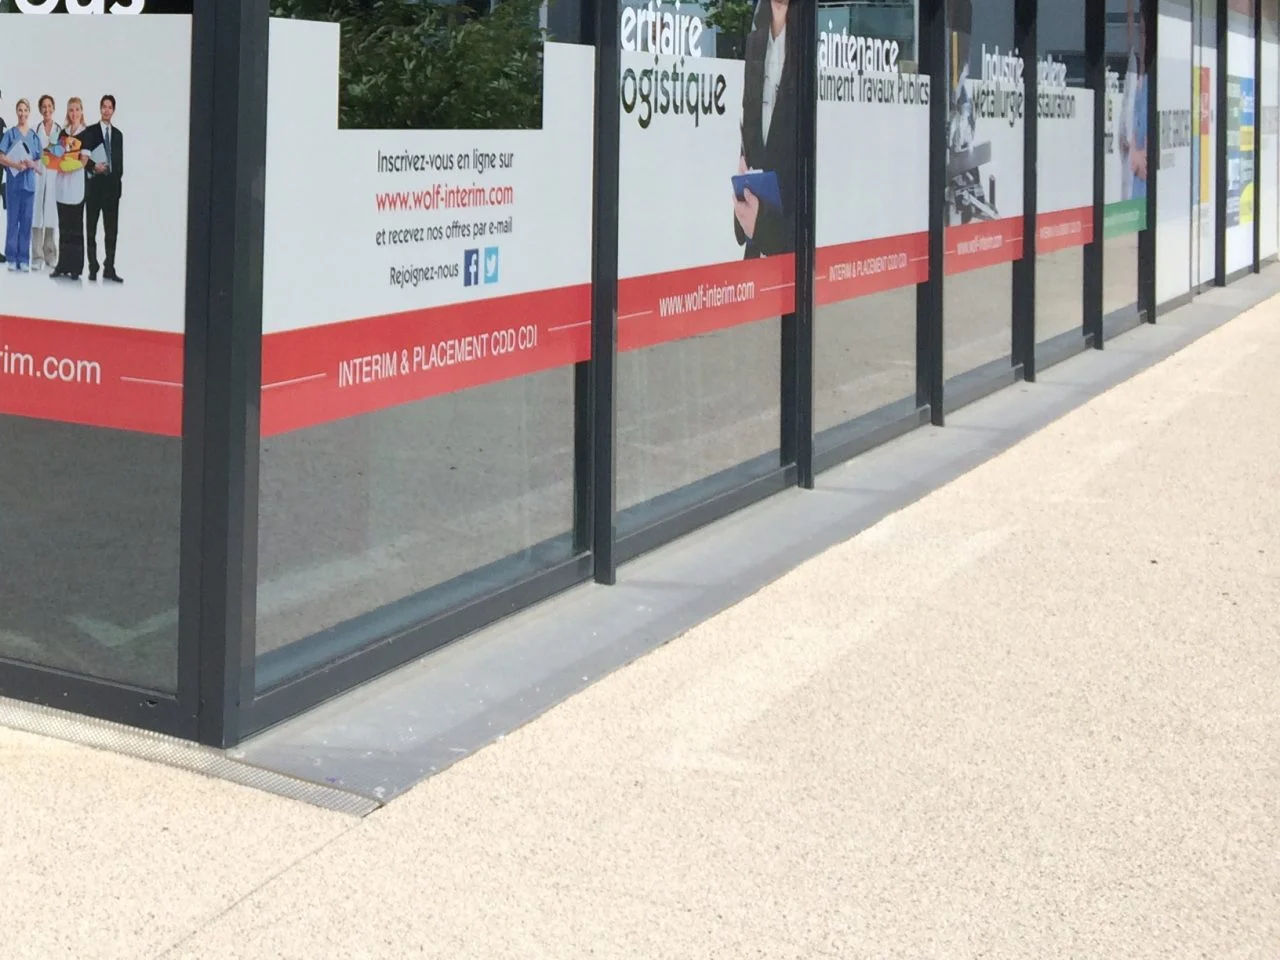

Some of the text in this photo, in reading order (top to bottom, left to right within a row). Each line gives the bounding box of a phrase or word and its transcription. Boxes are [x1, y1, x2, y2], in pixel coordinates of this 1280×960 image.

[818, 19, 899, 73] aintenance
[621, 55, 727, 129] ogistique
[819, 67, 855, 102] timent
[857, 70, 895, 103] Travaux
[377, 148, 514, 174] Inscrivez-vous en ligne sur
[376, 183, 513, 212] www.wolf-interim.com
[375, 216, 512, 246] et recevez nos offres par e-mail
[390, 262, 459, 288] Rejoignez-nous
[659, 280, 755, 317] www.wolf-interim.com
[338, 325, 537, 387] INTERIM & PLACEMENT CDD CDI
